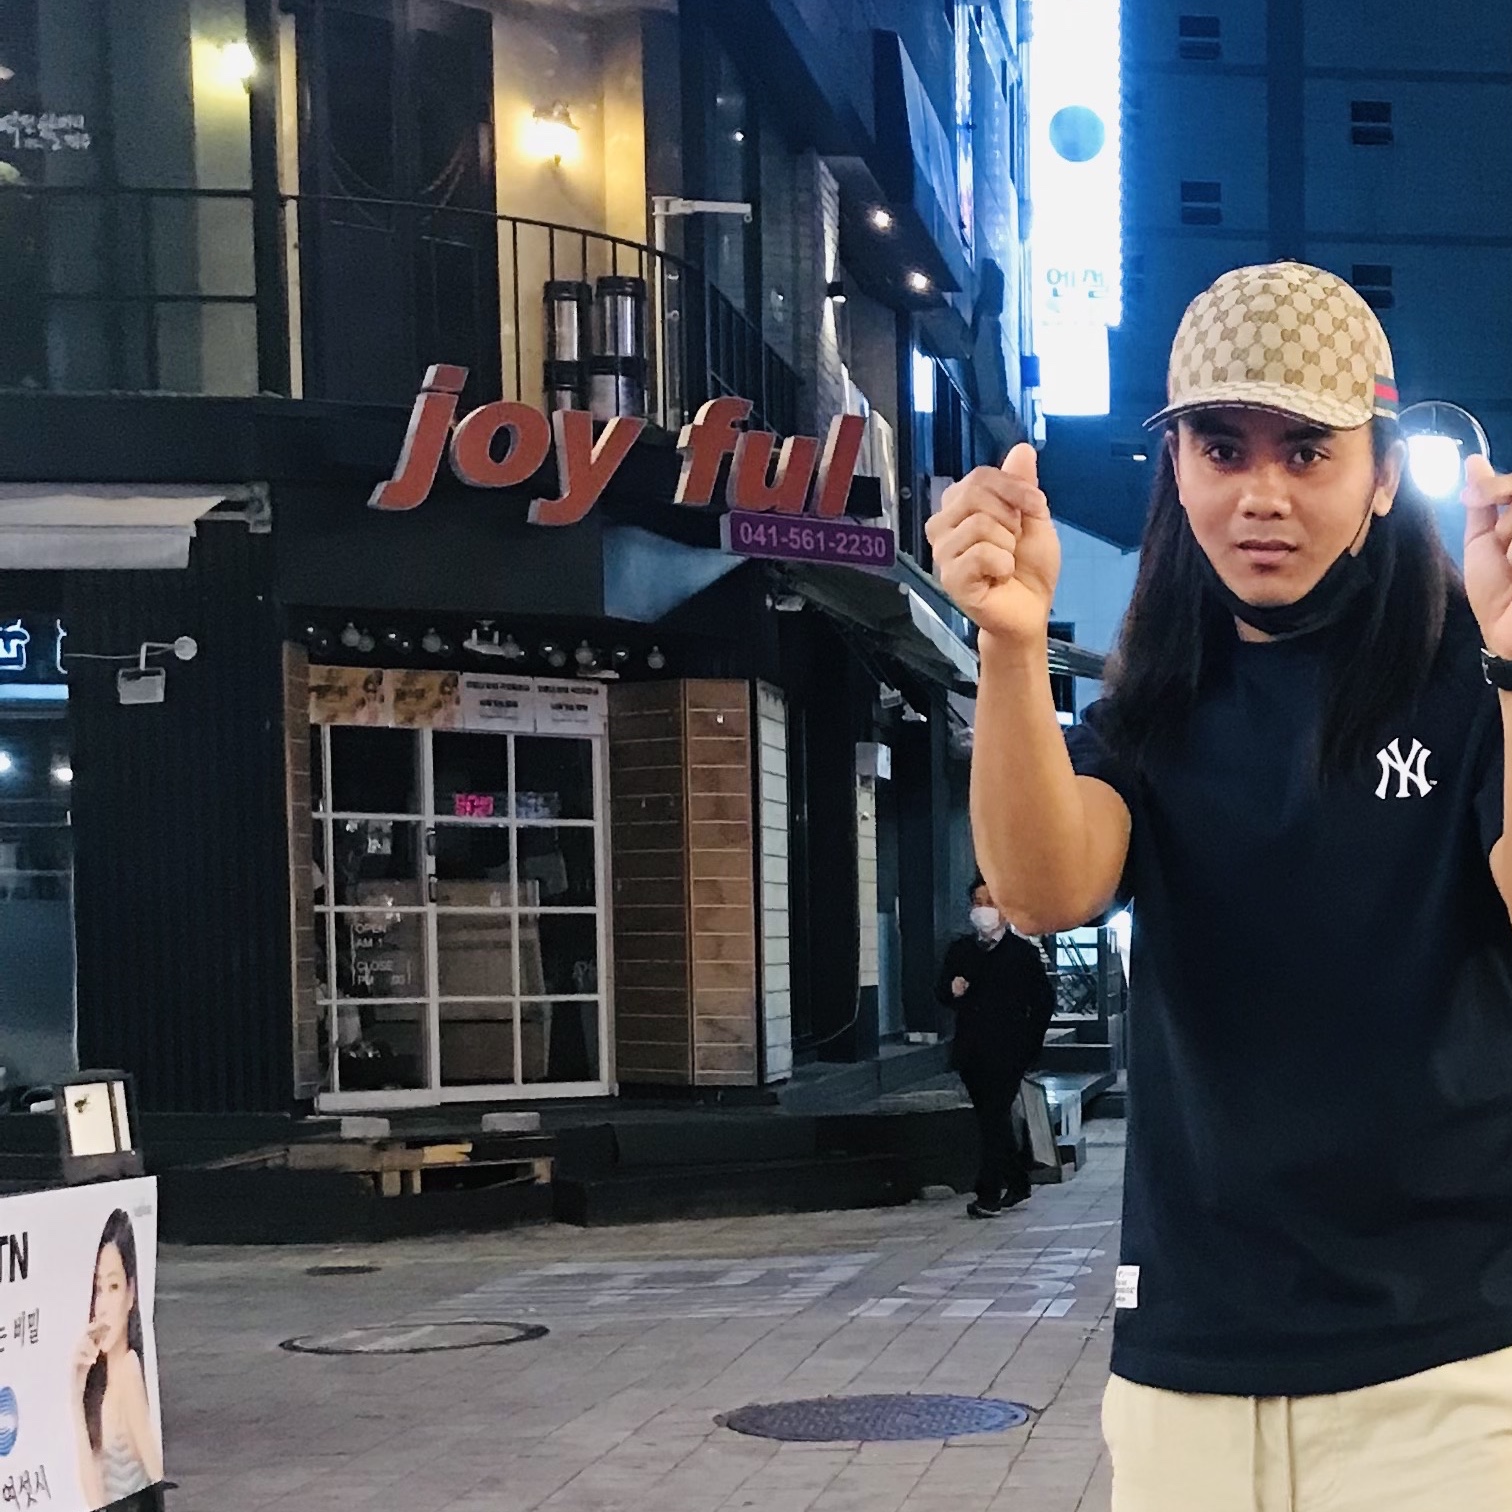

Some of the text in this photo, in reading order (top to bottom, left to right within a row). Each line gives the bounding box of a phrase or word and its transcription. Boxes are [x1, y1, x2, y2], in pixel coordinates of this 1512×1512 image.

[367, 364, 864, 525] joy ful
[740, 522, 886, 558] 041-561-2230
[1375, 737, 1433, 800] NY
